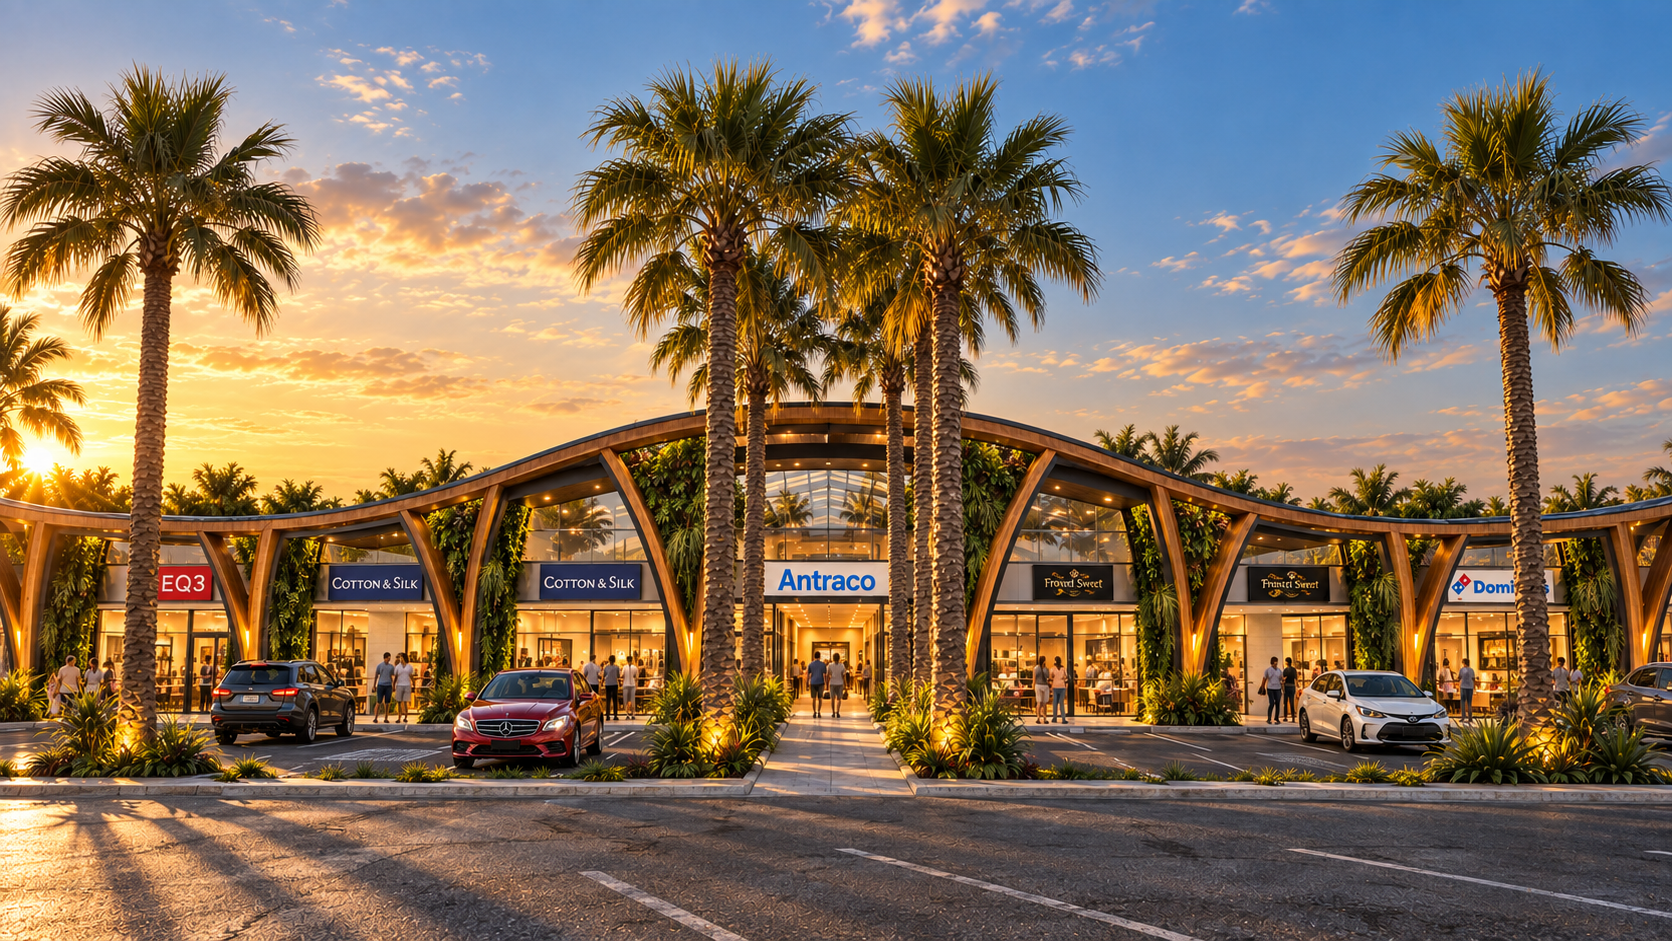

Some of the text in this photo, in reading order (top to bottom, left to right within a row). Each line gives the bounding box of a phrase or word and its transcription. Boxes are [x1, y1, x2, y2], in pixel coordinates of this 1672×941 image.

[162, 574, 205, 593] EQ3
[332, 576, 380, 590] COTTON
[382, 579, 392, 590] &
[544, 575, 635, 589] COTTON & SILK
[777, 568, 876, 592] Antraco
[1473, 579, 1550, 595] Domis
